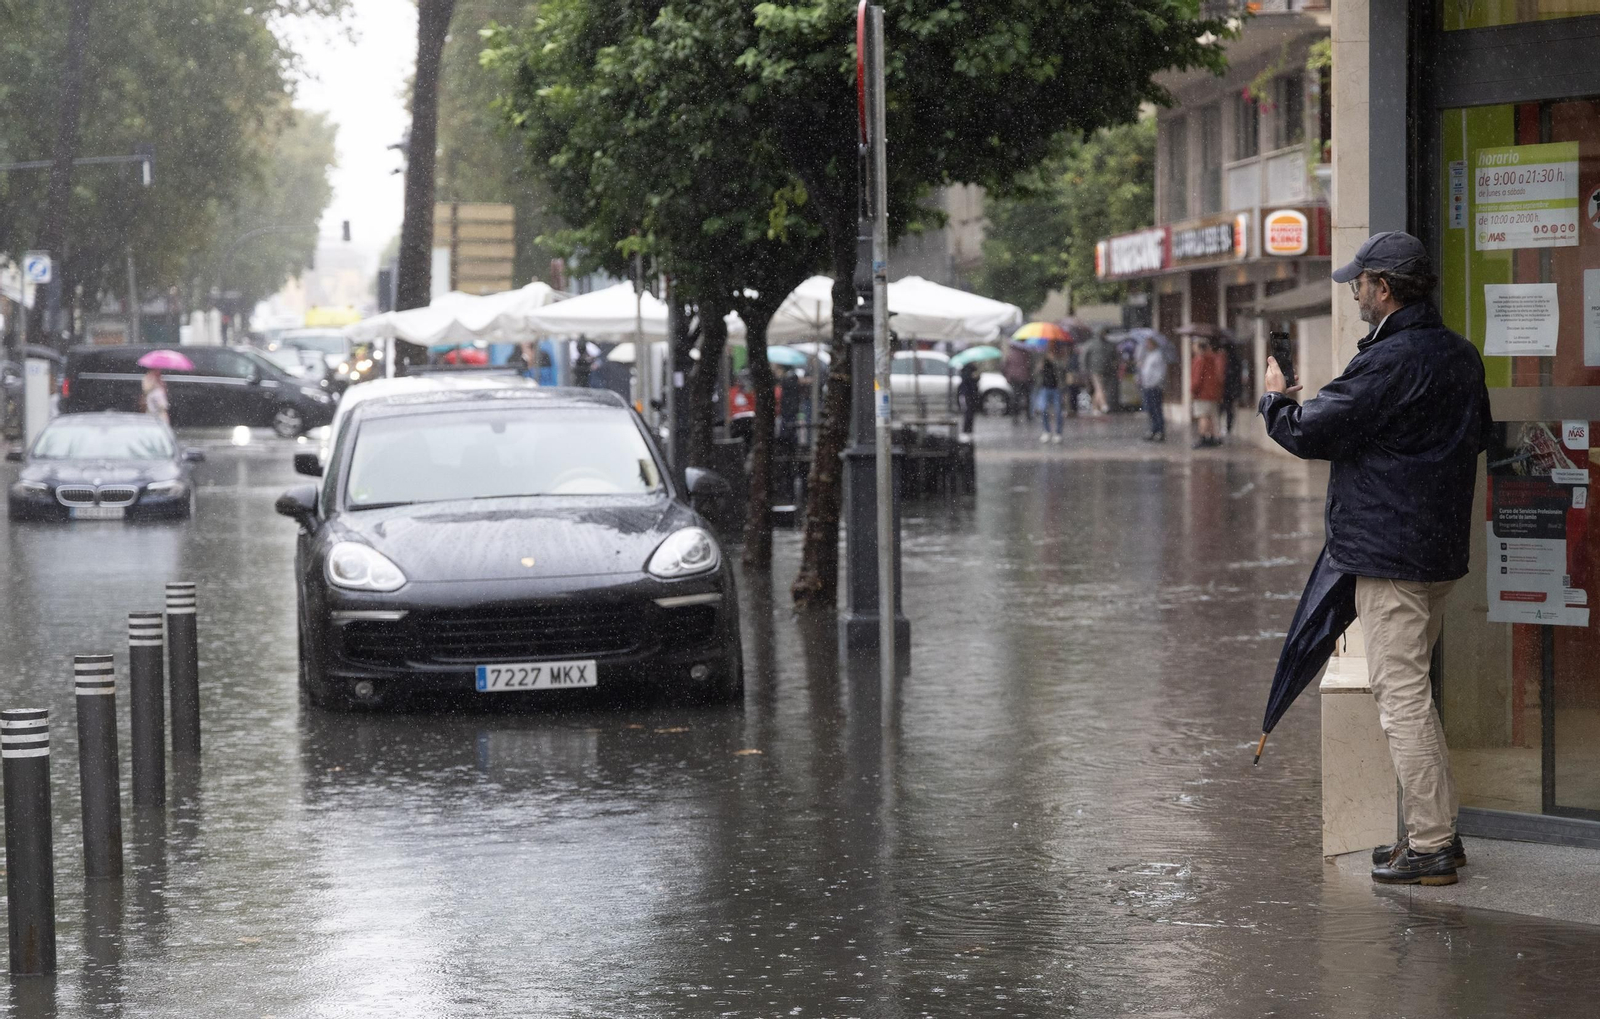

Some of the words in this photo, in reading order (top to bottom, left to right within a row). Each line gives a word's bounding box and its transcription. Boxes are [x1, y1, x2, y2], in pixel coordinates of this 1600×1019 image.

[1478, 150, 1519, 165] horario
[1478, 174, 1490, 187] de
[1493, 171, 1516, 186] 9:00
[1519, 175, 1523, 184] a
[1526, 169, 1554, 184] 21:30
[1556, 167, 1565, 182] h.
[1478, 189, 1485, 197] de
[1486, 188, 1501, 197] lunes
[1507, 187, 1526, 196] sábado
[1478, 216, 1488, 226] de
[1490, 214, 1508, 225] 10:00
[1510, 216, 1514, 224] a
[1516, 213, 1534, 224] 20:00
[1488, 232, 1506, 242] MAS
[1568, 430, 1585, 438] MAS
[490, 667, 542, 687] 7227
[550, 665, 587, 685] MKX
